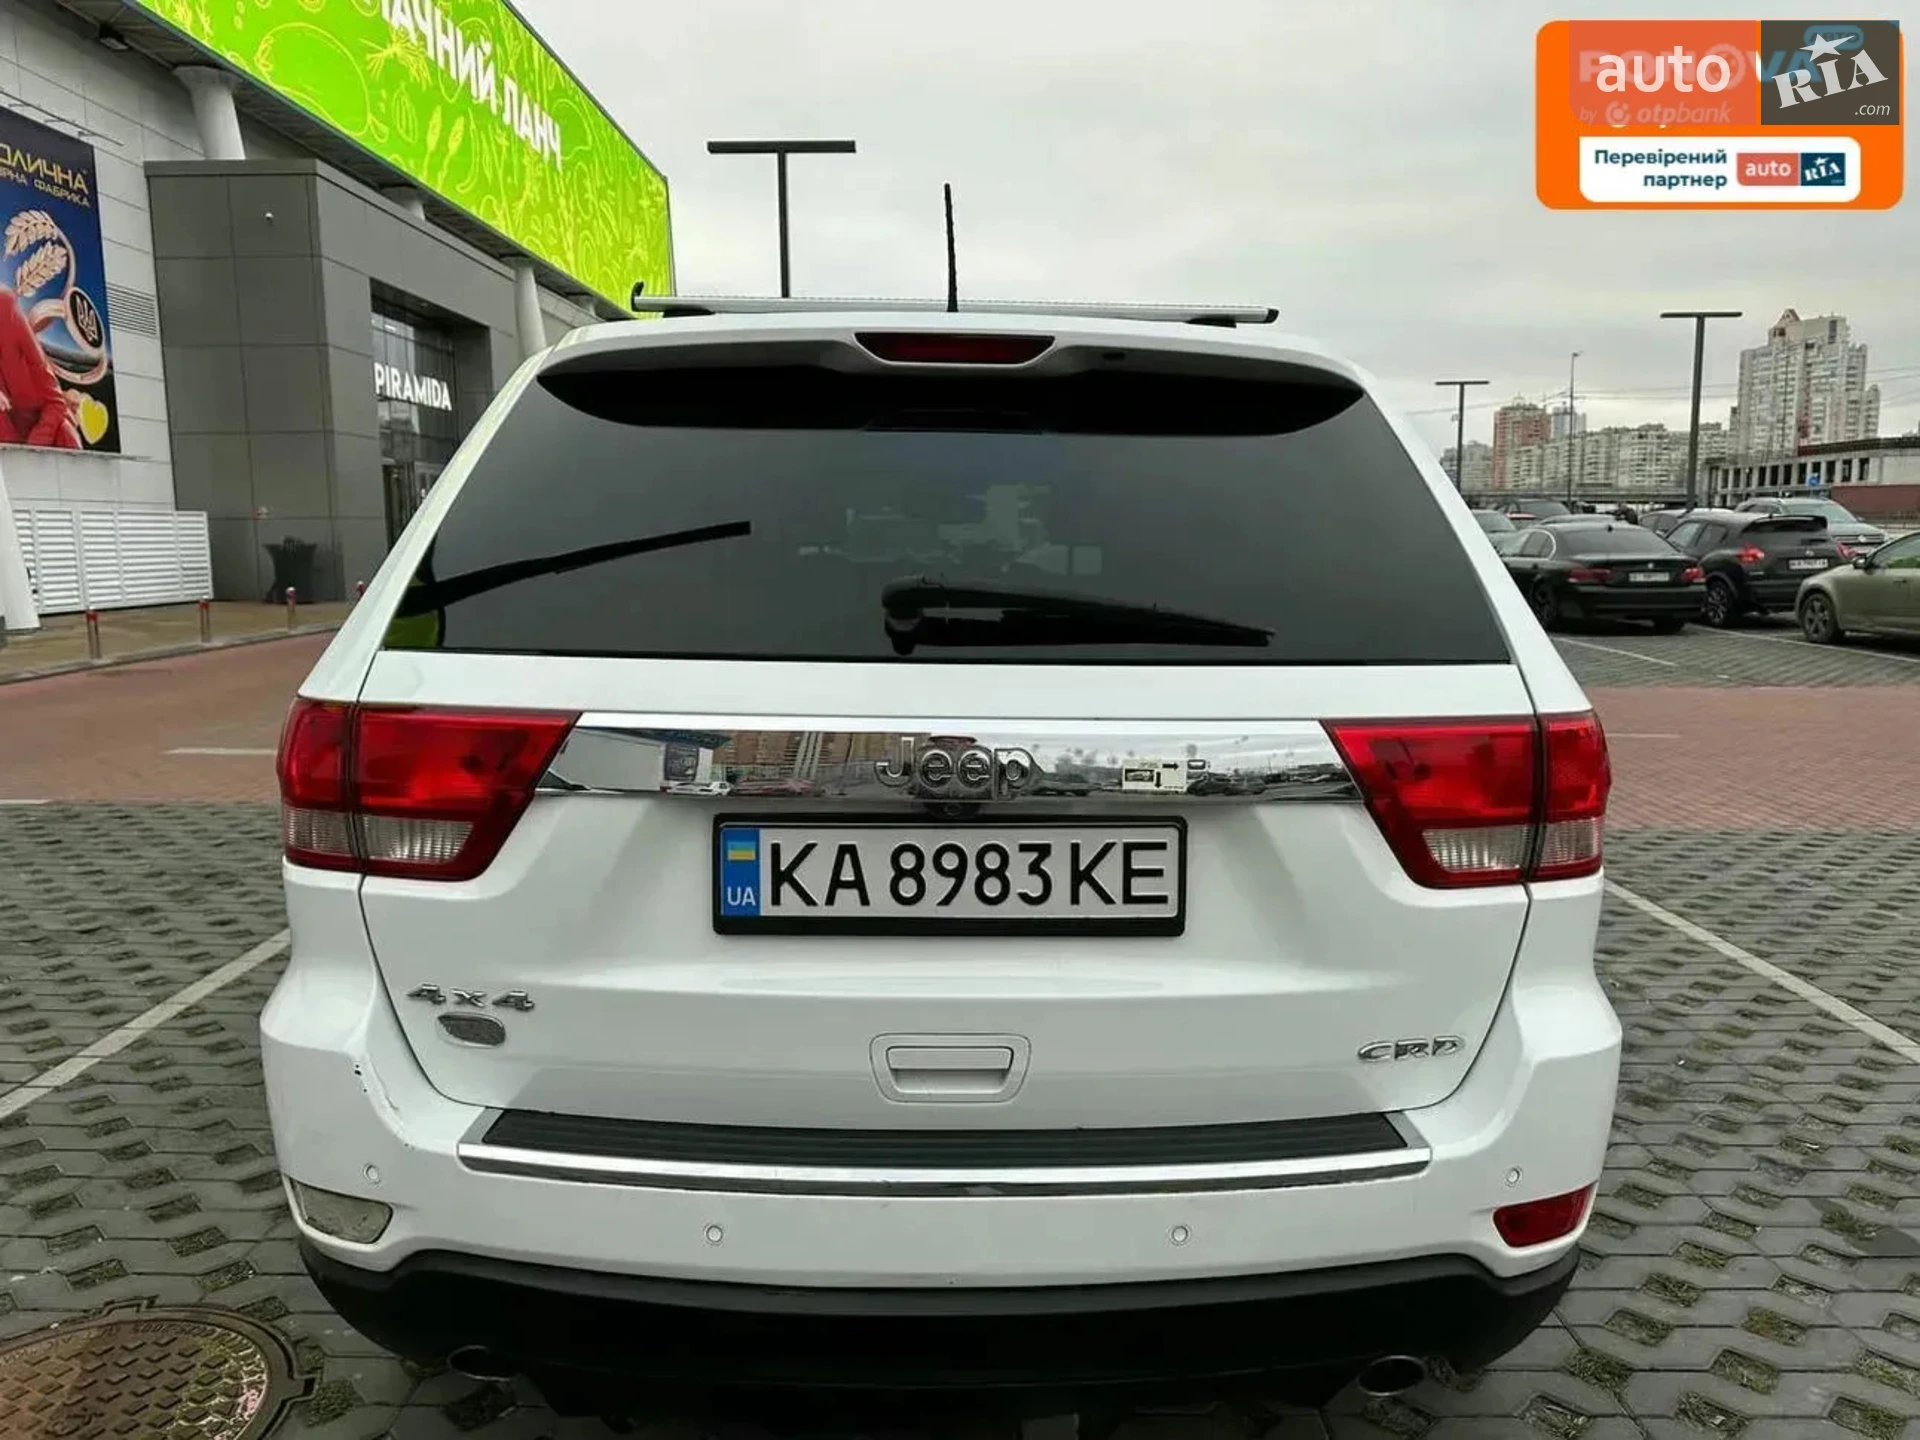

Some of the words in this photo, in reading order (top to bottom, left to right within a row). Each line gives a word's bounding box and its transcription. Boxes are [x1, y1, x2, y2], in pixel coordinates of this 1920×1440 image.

[381, 0, 497, 116] АЧНИЙ
[503, 74, 561, 174] ЛАНЧ
[33, 178, 91, 208] ФАБРИКА
[374, 361, 452, 411] PIRAMIDA
[874, 736, 1034, 798] Jeep
[727, 886, 757, 906] UA
[769, 841, 871, 907] KA
[889, 842, 1053, 907] 8983
[1069, 841, 1169, 906] KE
[1358, 1036, 1465, 1062] CRD
